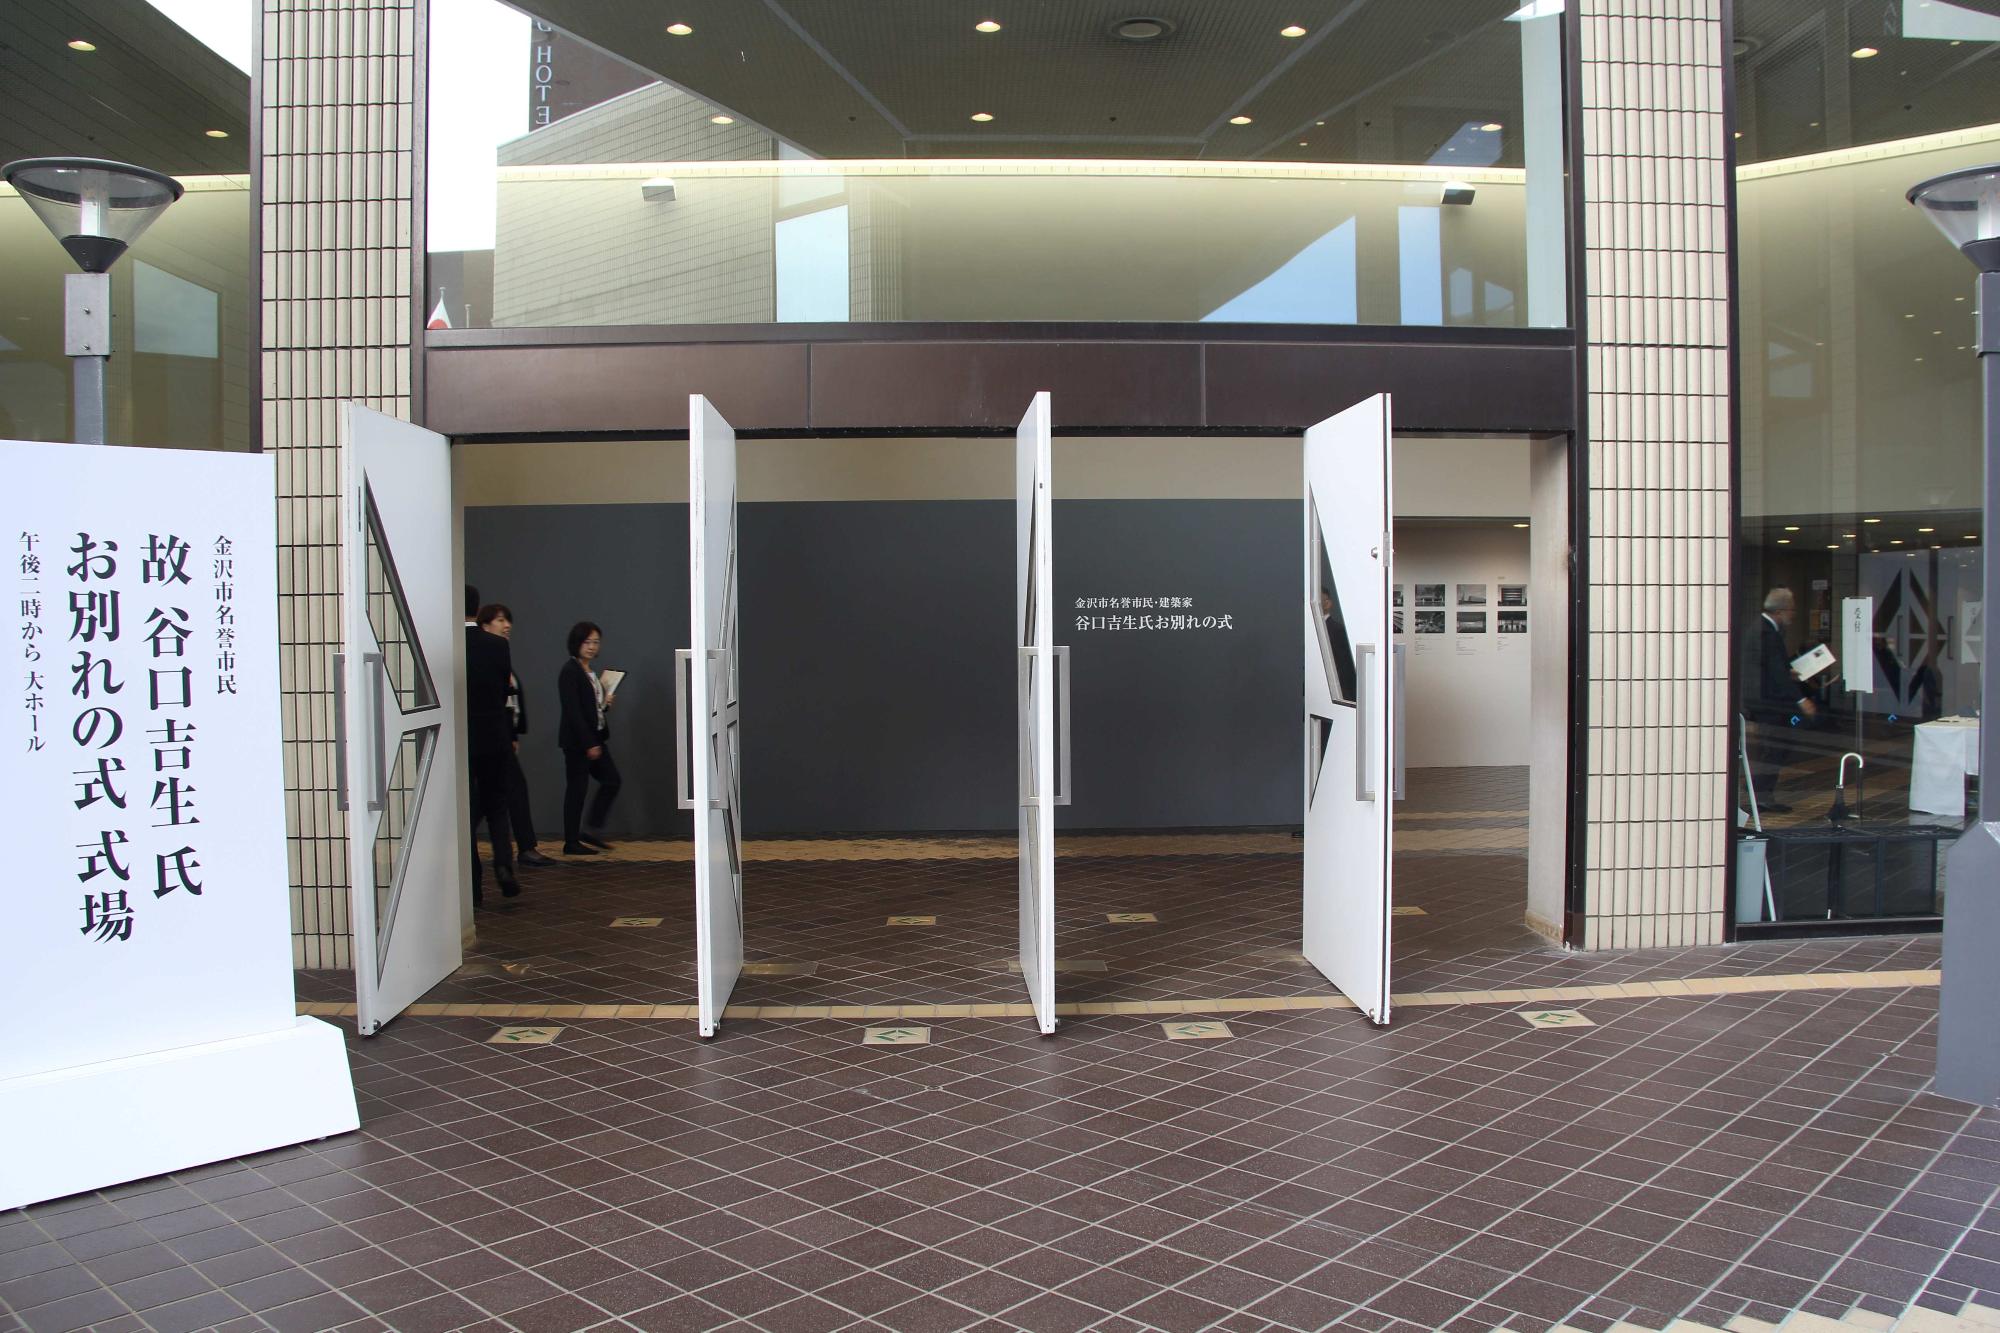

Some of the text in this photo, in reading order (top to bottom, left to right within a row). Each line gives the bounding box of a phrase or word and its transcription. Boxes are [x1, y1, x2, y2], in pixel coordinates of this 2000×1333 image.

[20, 531, 45, 752] 午後二時から 大ホール
[214, 535, 237, 695] 金沢市名誉市民
[1075, 597, 1193, 609] 金沢市名誉市民・建築家
[1075, 614, 1233, 631] 谷口吉生氏お別れの式
[66, 532, 135, 943] お別れの式 式場
[140, 533, 203, 900] 故 谷口吉生 氏
